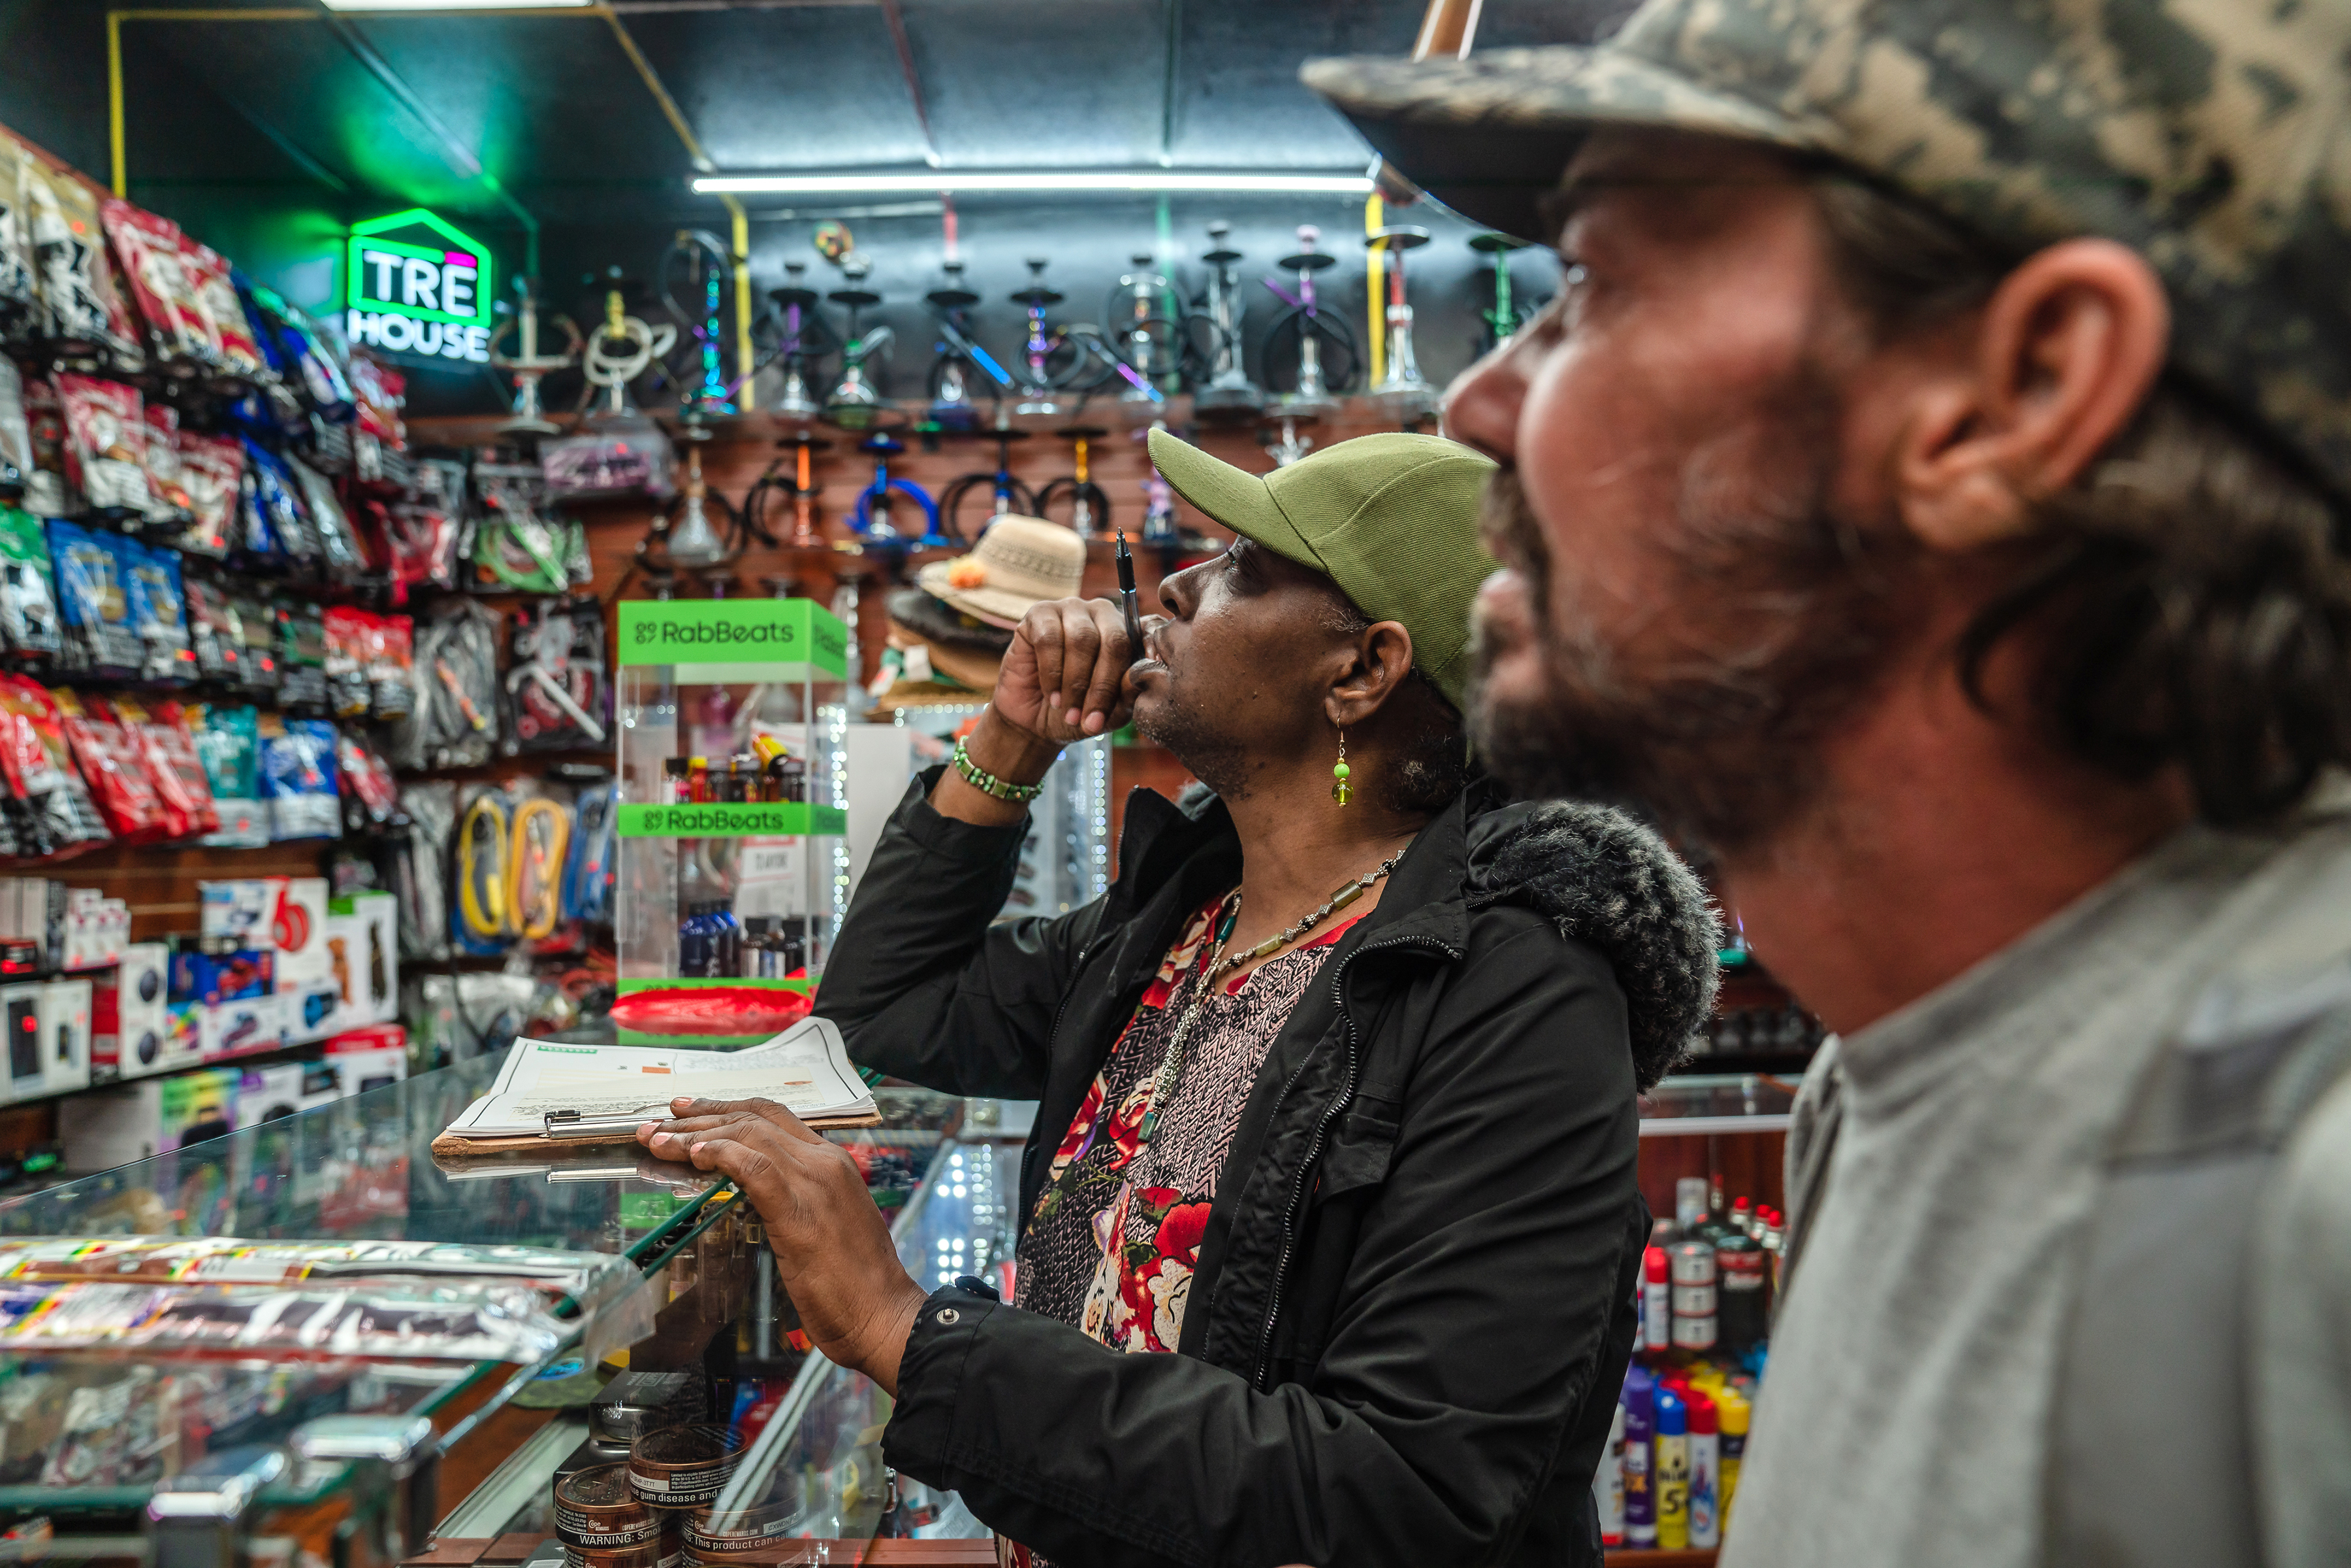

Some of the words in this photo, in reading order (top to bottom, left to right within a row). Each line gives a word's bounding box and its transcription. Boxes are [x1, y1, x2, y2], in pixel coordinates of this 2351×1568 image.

[347, 308, 491, 363] HOUSE
[662, 620, 795, 644] RabBeats
[667, 810, 784, 831] RabBeats
[640, 1491, 656, 1501] gum
[658, 1493, 696, 1502] disease
[699, 1489, 717, 1501] and
[588, 1520, 601, 1528] Cope
[580, 1533, 635, 1545] WARNING:
[722, 1528, 758, 1537] COPEREWARDS.COM
[694, 1536, 711, 1548] This
[713, 1541, 752, 1550] product
[755, 1537, 773, 1547] can
